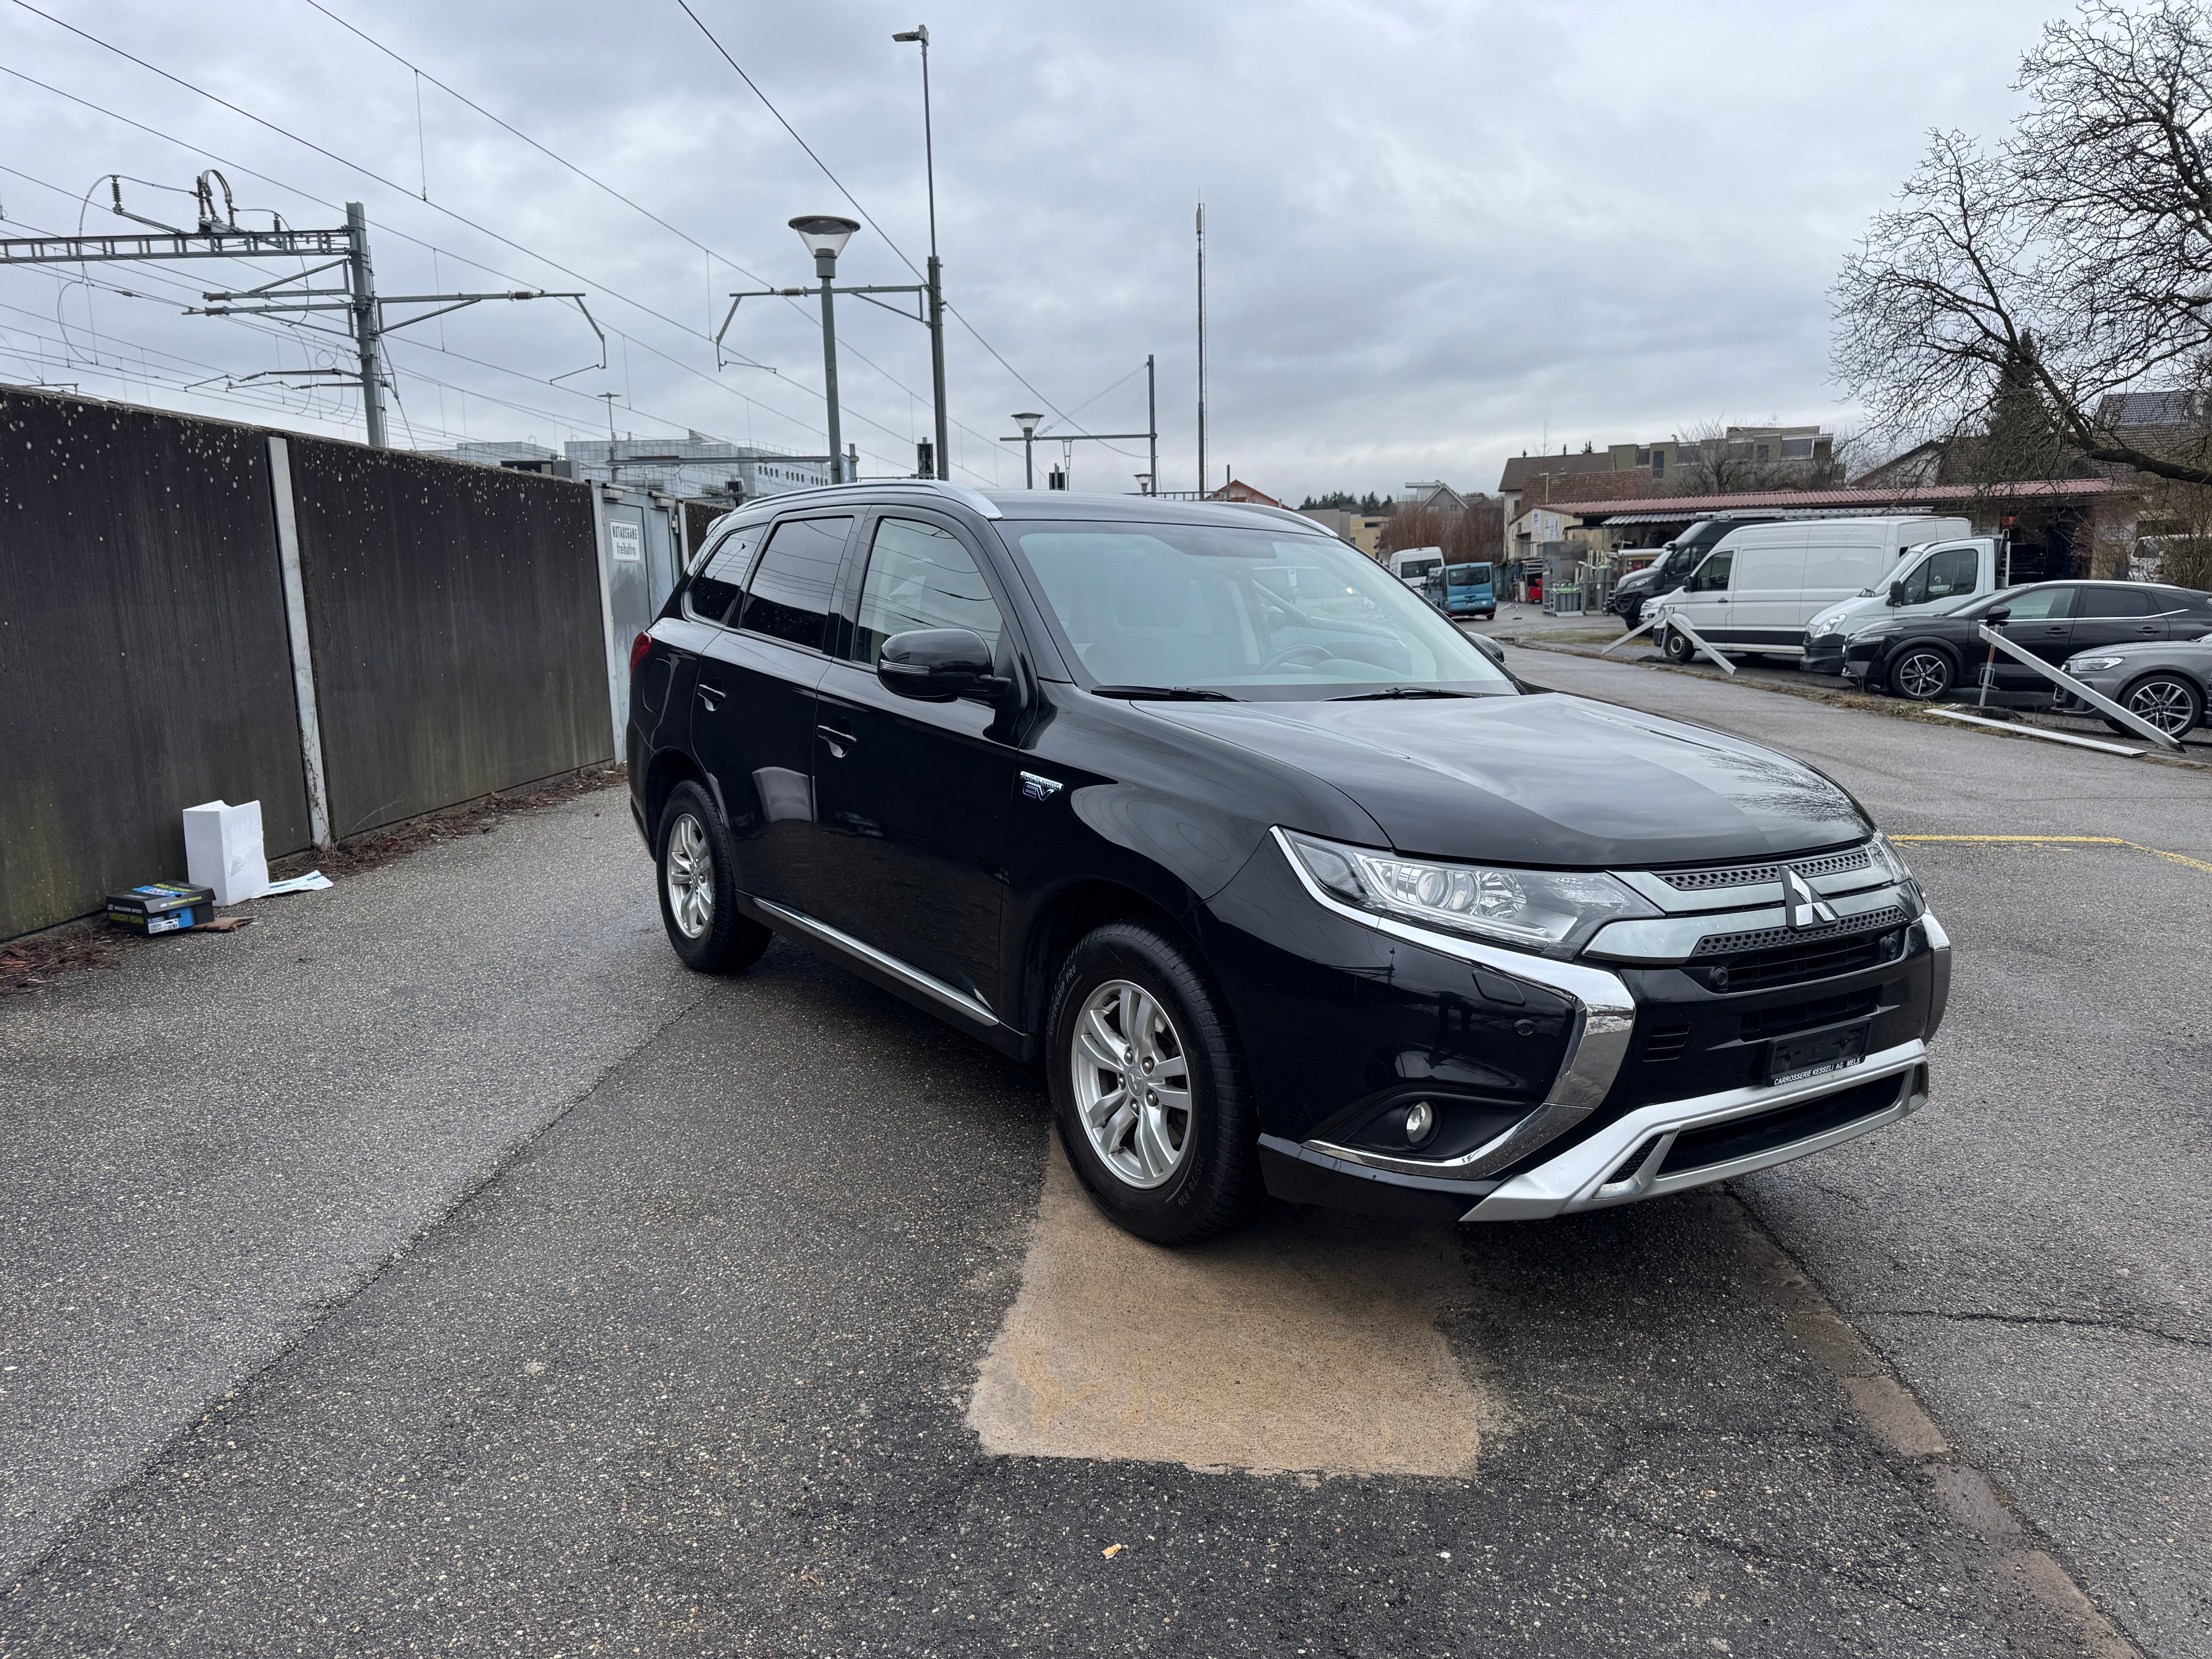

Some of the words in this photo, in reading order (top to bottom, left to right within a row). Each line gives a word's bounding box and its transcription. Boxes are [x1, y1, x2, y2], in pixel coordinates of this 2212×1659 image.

[612, 526, 637, 540] NOTAUSGANG
[617, 542, 636, 555] freihalten
[1023, 781, 1054, 802] EV
[1041, 778, 1060, 790] HYBRID
[1049, 981, 1065, 1038] SUPERGRIP
[1065, 964, 1076, 983] PRO
[1774, 1070, 1812, 1086] CARROSSERIE
[1812, 1065, 1834, 1076] KESSELI
[1846, 1057, 1860, 1066] MELS
[1188, 1153, 1205, 1191] 215/70
[1178, 1190, 1191, 1208] R16
